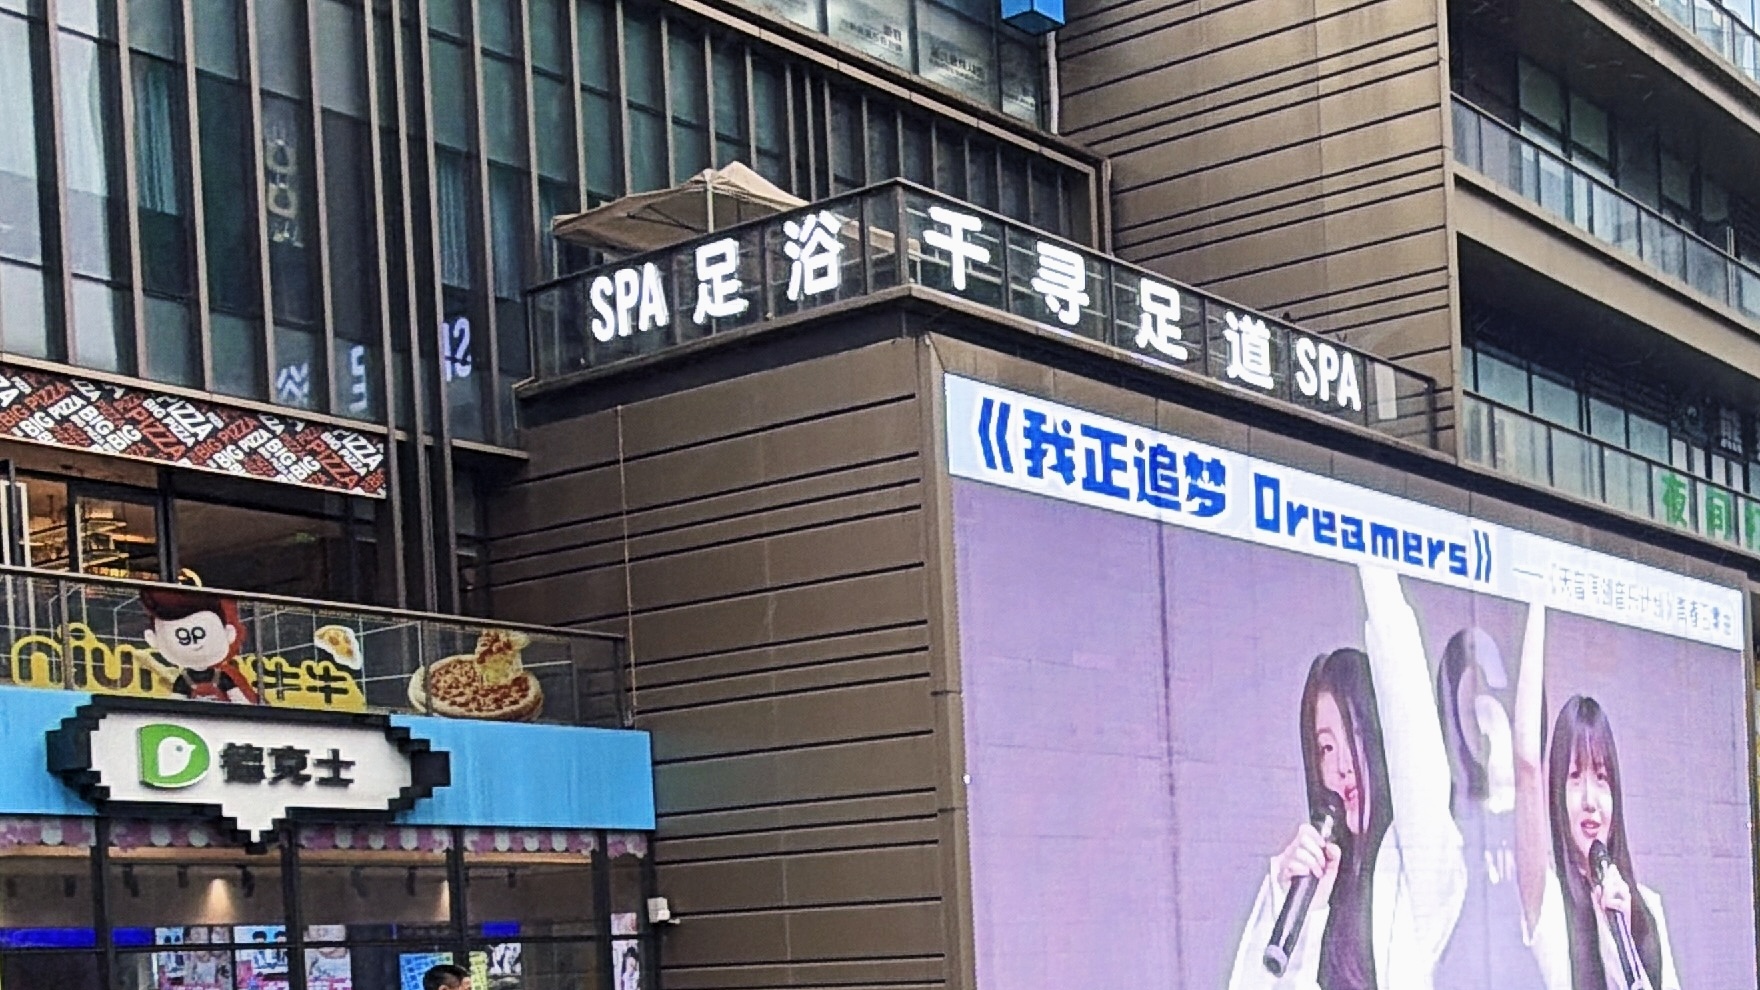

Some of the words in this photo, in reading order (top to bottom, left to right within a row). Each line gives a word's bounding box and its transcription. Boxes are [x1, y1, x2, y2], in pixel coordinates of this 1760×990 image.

[693, 210, 844, 323] 足浴
[590, 263, 667, 341] SPA
[1295, 337, 1362, 411] SPA
[19, 412, 55, 437] BIG
[48, 395, 88, 420] PIZZA
[78, 405, 115, 435] BIG
[107, 425, 142, 450] BIG
[213, 445, 245, 467] BIG
[238, 429, 273, 452] PIZZA
[265, 438, 297, 466] BIG
[290, 455, 321, 480] BIG
[976, 397, 1227, 518] 《我正追梦
[1254, 473, 1493, 583] Dreamers》
[219, 742, 356, 788] 德克士
